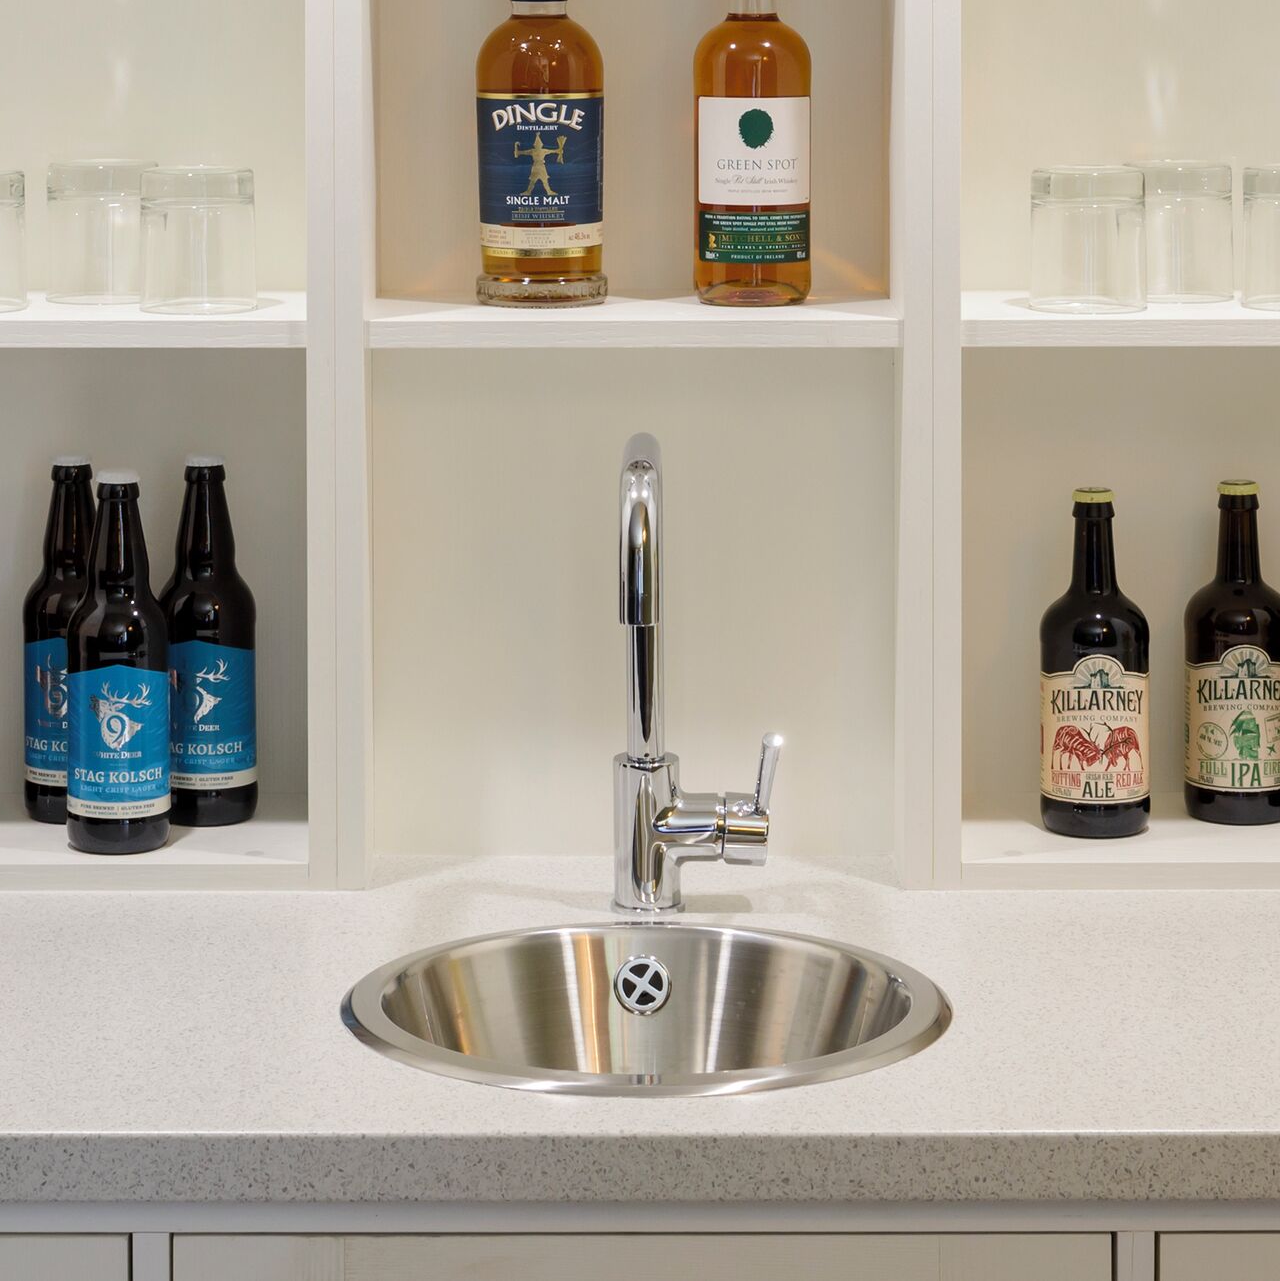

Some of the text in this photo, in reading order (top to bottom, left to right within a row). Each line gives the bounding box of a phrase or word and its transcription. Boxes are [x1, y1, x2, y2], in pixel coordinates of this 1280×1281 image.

[492, 102, 586, 132] DINGLE
[717, 158, 798, 170] GREEN SPOT
[506, 196, 571, 206] SINGLE MALT
[722, 234, 773, 242] MITCHELL
[1051, 690, 1143, 715] KILLARNEY
[1204, 704, 1243, 712] BREWING
[1057, 715, 1138, 723] BREWING COMPANY
[199, 724, 220, 732] DEER
[121, 751, 142, 759] DEER
[171, 741, 242, 756] AG KOLSCH
[1200, 762, 1227, 775] FULL
[1231, 763, 1262, 787] IPA
[75, 767, 162, 784] STAG KOLSCH
[1052, 772, 1081, 788] RUTTING
[1116, 772, 1143, 788] RED ALE
[81, 784, 103, 793] LIGHT
[132, 784, 157, 793] LAGER
[1082, 782, 1115, 798] ALE
